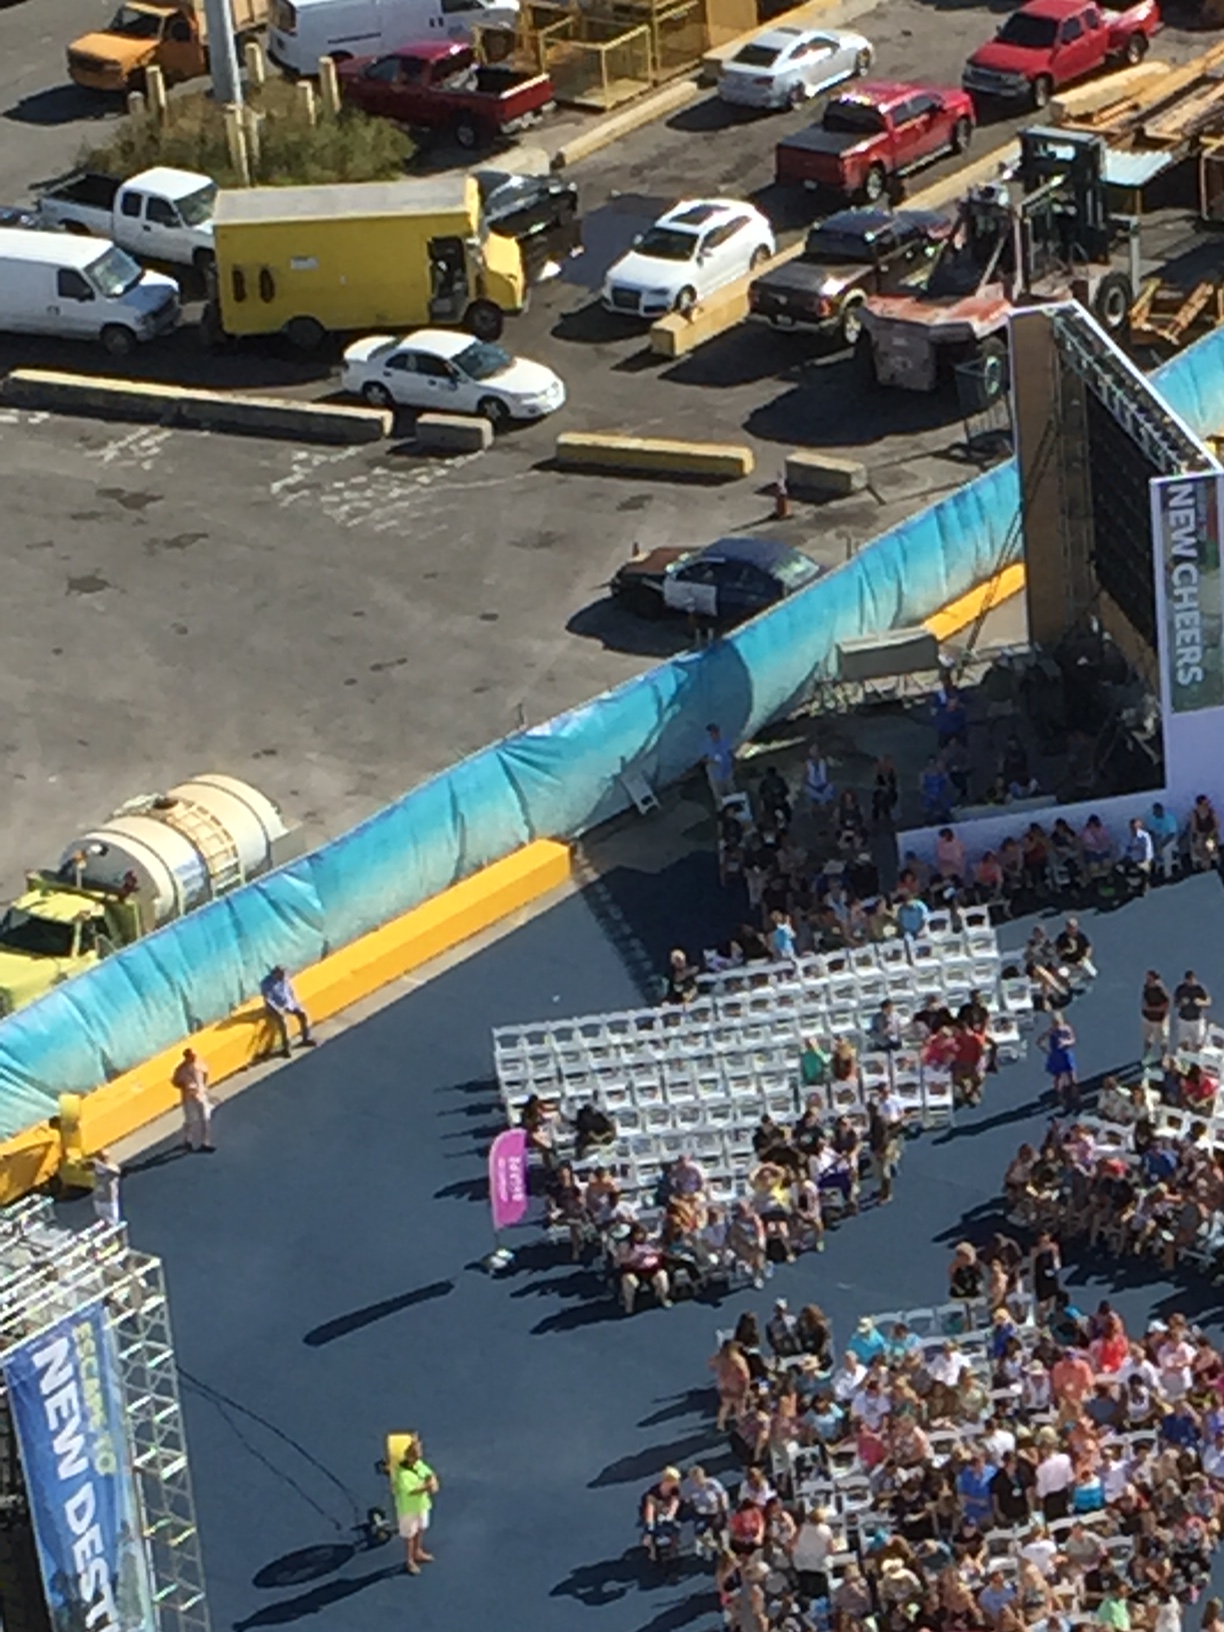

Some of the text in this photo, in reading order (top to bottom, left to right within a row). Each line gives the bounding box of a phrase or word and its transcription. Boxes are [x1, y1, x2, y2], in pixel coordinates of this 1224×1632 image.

[1167, 484, 1203, 686] NEW CHEERS
[31, 1337, 89, 1480] NEW
